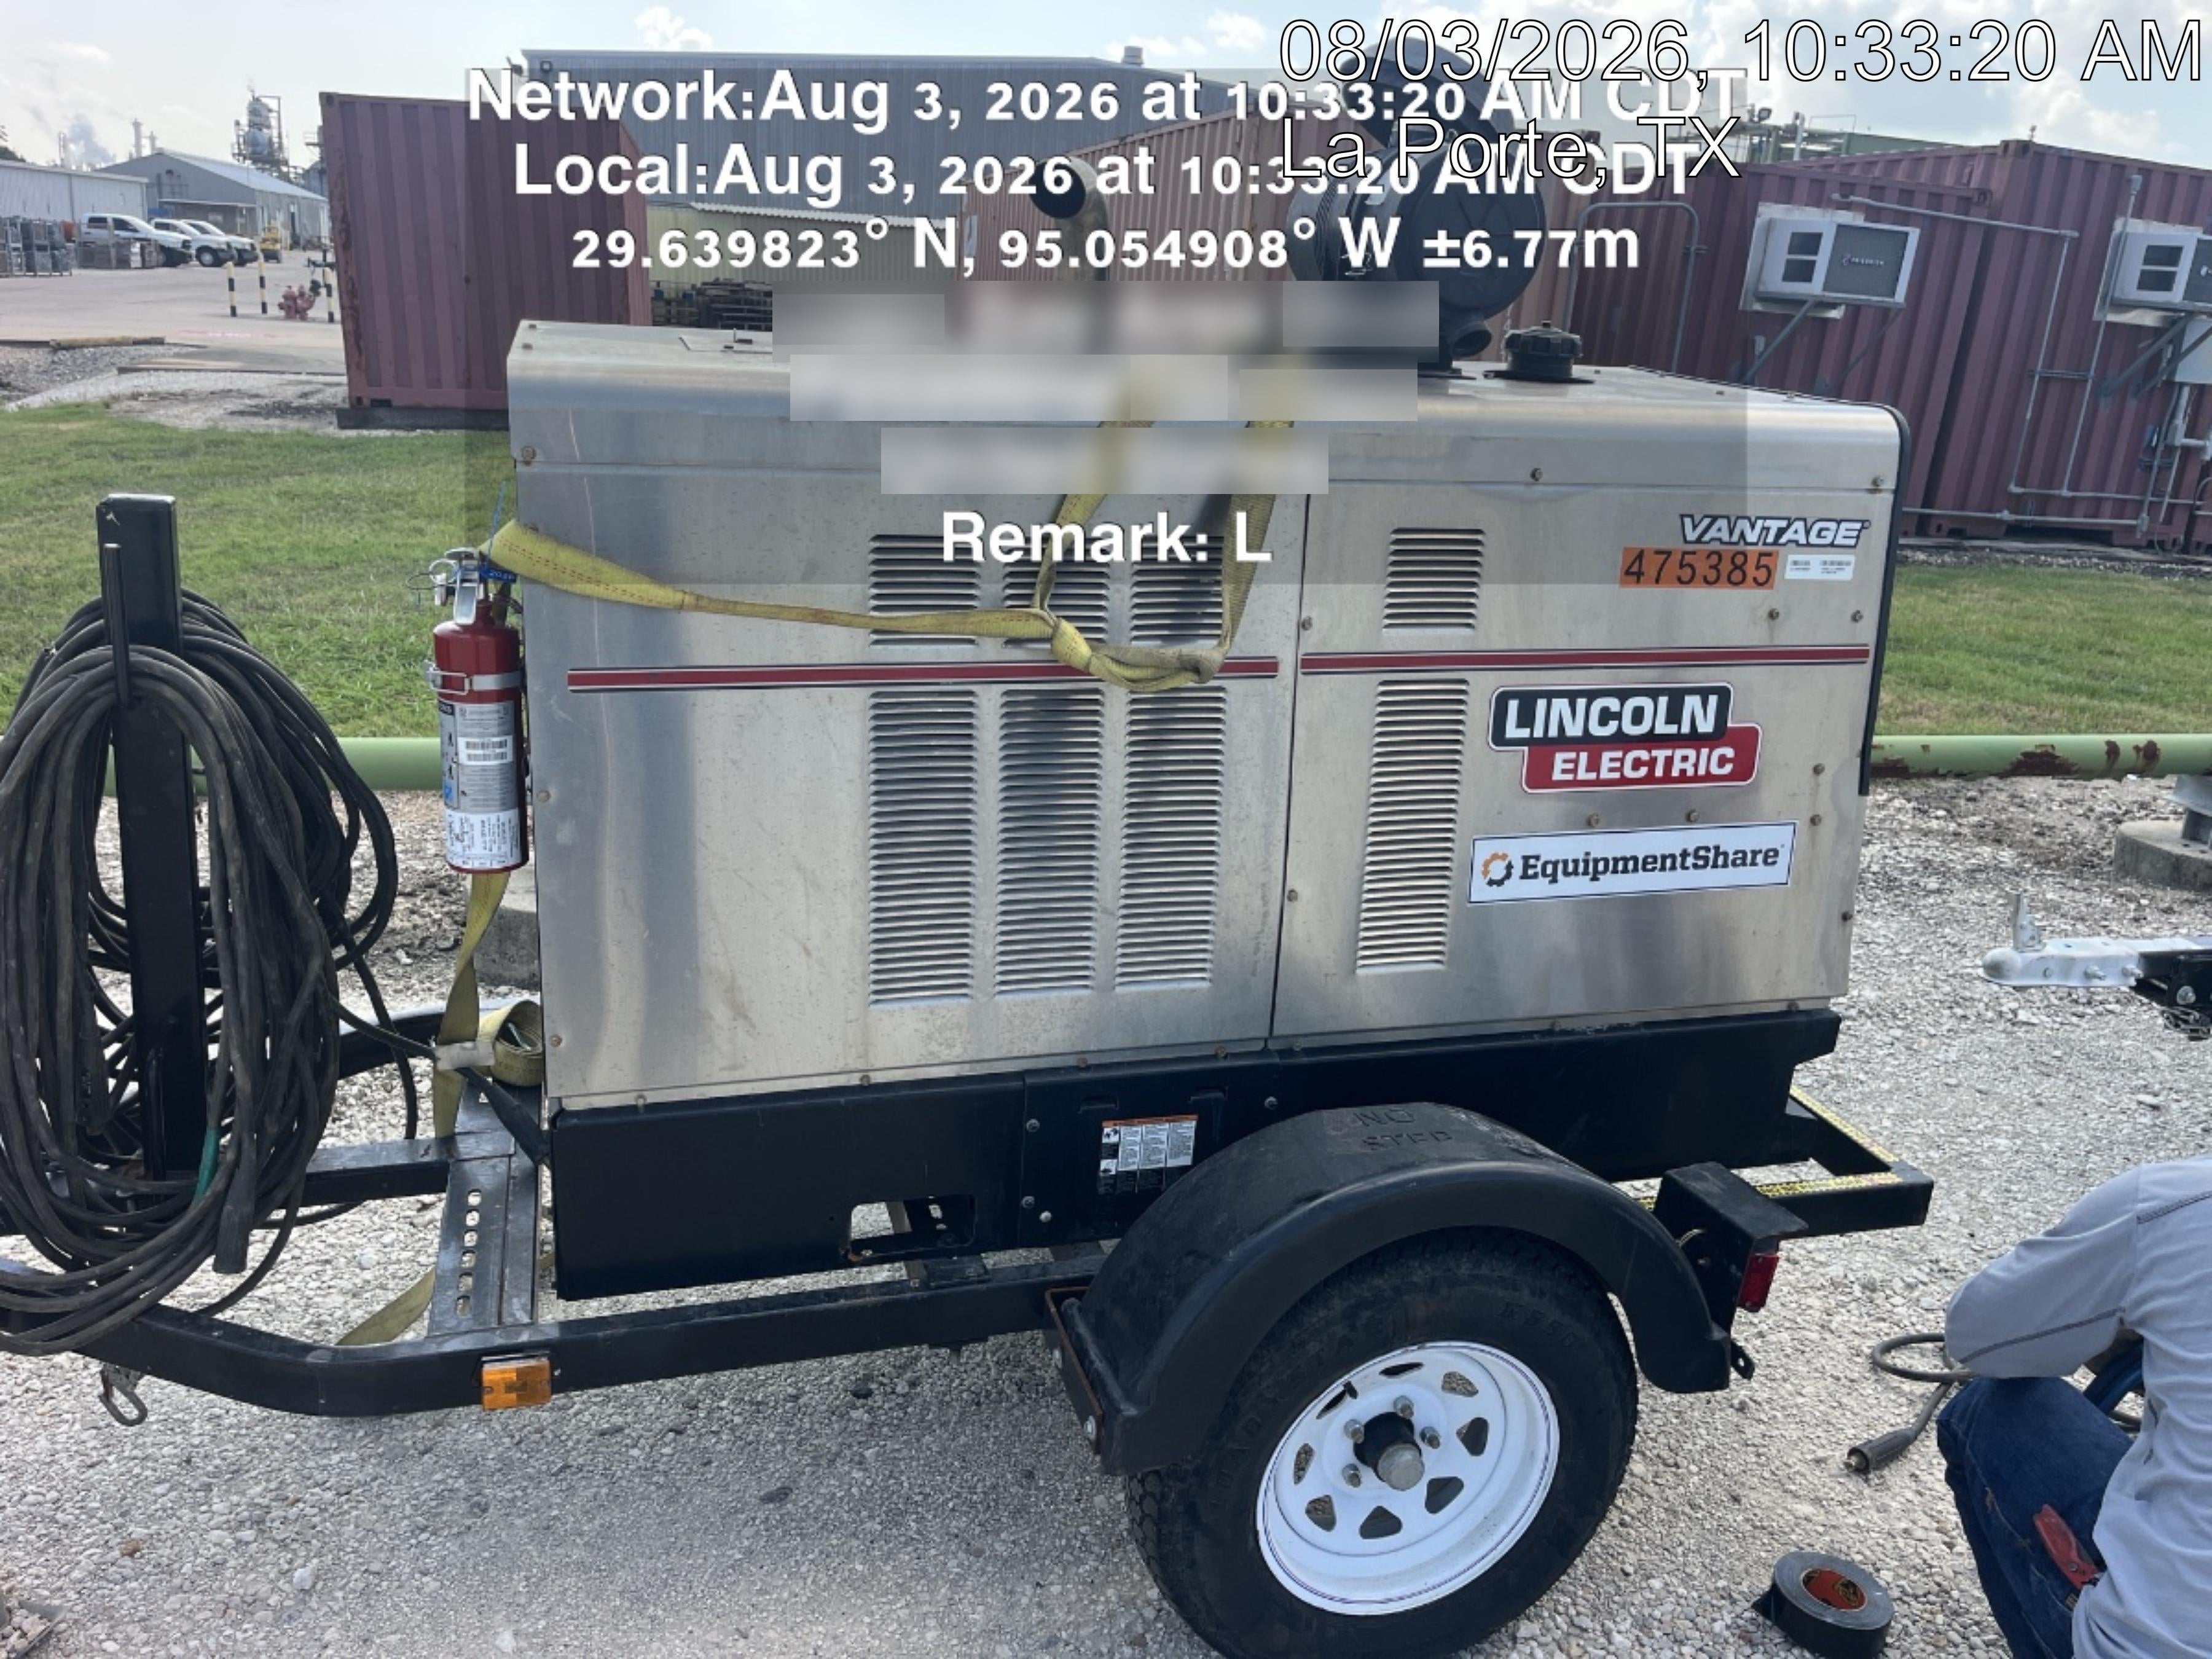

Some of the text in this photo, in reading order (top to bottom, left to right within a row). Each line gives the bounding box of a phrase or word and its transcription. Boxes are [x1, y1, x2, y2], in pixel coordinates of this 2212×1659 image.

[1679, 514, 1864, 548] VANTAGE
[1623, 547, 1774, 587] 475385
[1505, 694, 1719, 739] LINCOLN
[1551, 747, 1735, 781] ELECTRIC
[1519, 844, 1779, 885] EquipmentShare
